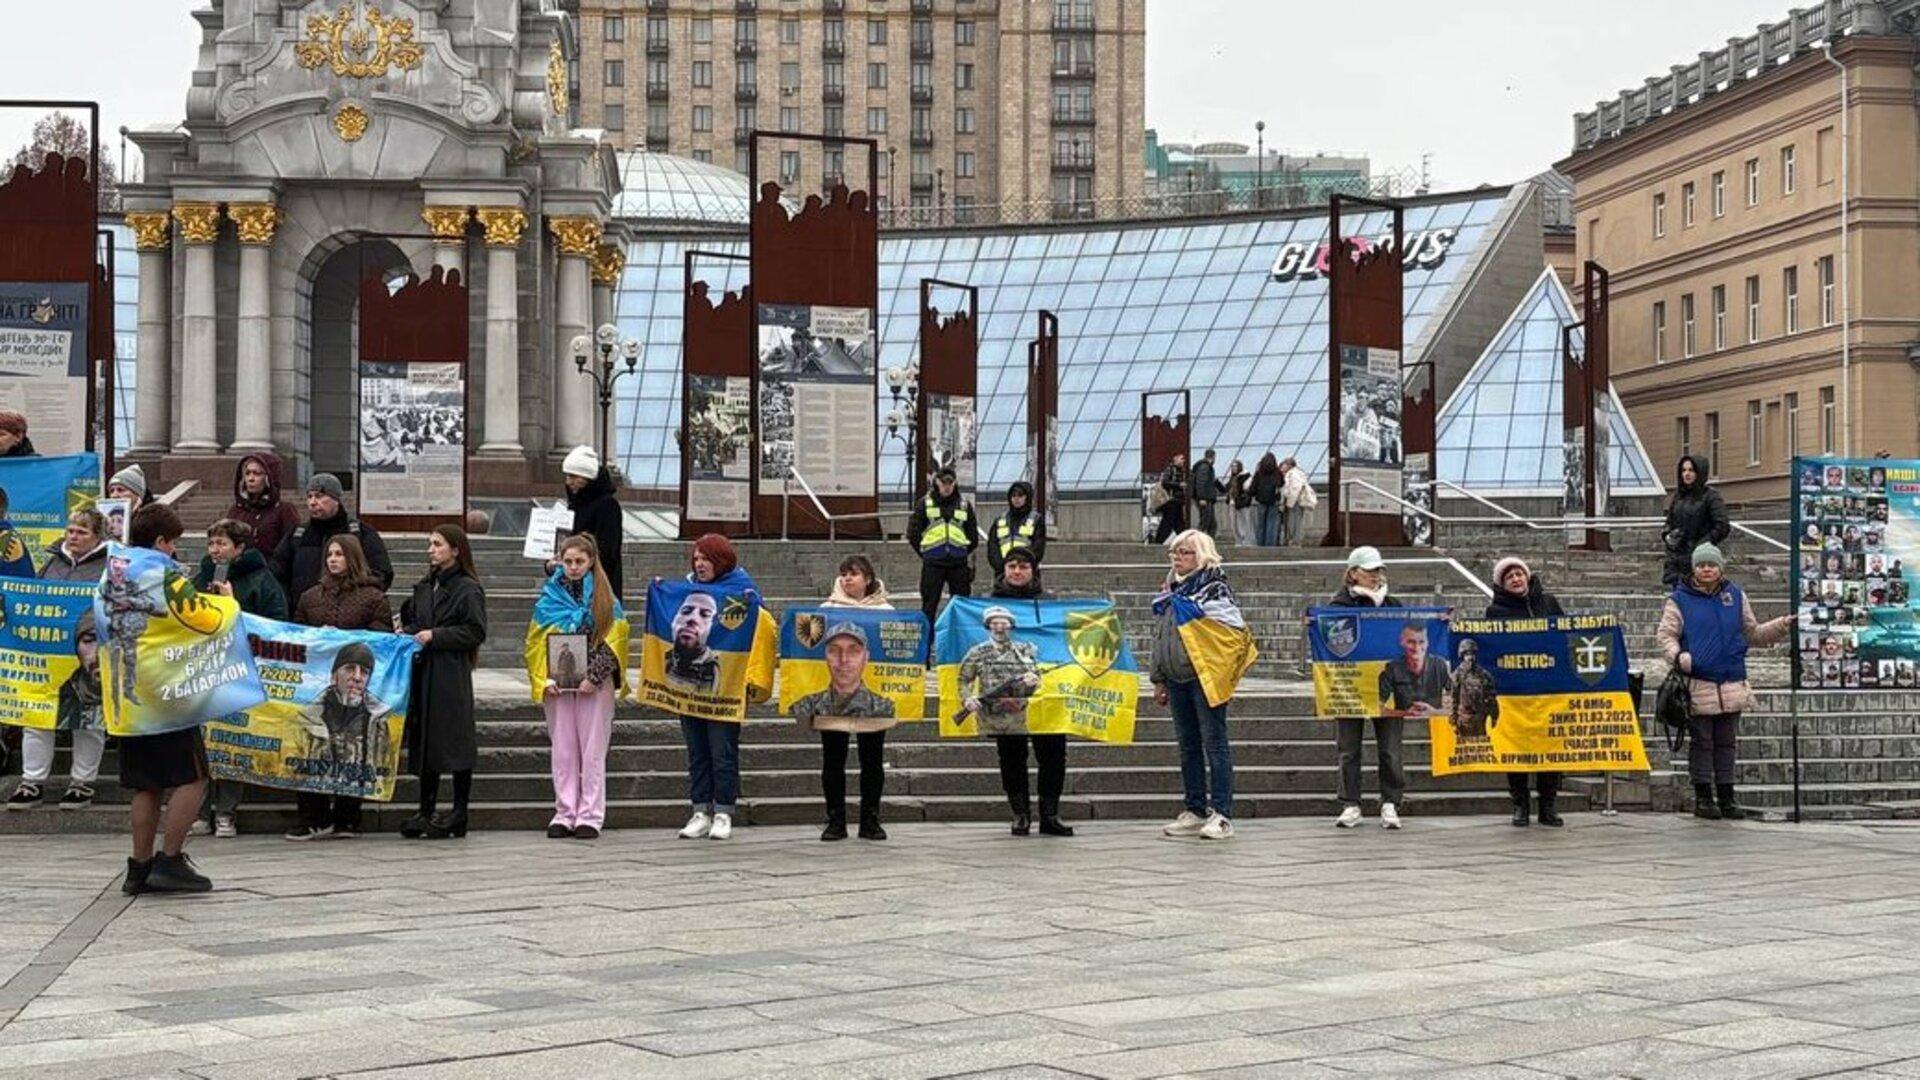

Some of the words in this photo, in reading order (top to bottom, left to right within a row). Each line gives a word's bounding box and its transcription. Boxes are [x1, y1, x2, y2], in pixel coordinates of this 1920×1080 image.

[21, 304, 80, 320] ГРНІТІ
[14, 603, 31, 616] 92
[1505, 618, 1548, 633] ЗНИКЛІ
[1558, 616, 1572, 630] НЕ
[163, 646, 184, 662] 92
[874, 665, 885, 677] 22
[161, 684, 171, 700] 2
[1548, 712, 1577, 724] ЗНИК
[1568, 724, 1634, 737] БОГДАНІВКА
[1501, 752, 1538, 764] ВІРИМО
[1595, 751, 1608, 762] НА
[1610, 750, 1633, 762] ТЕБЕ
